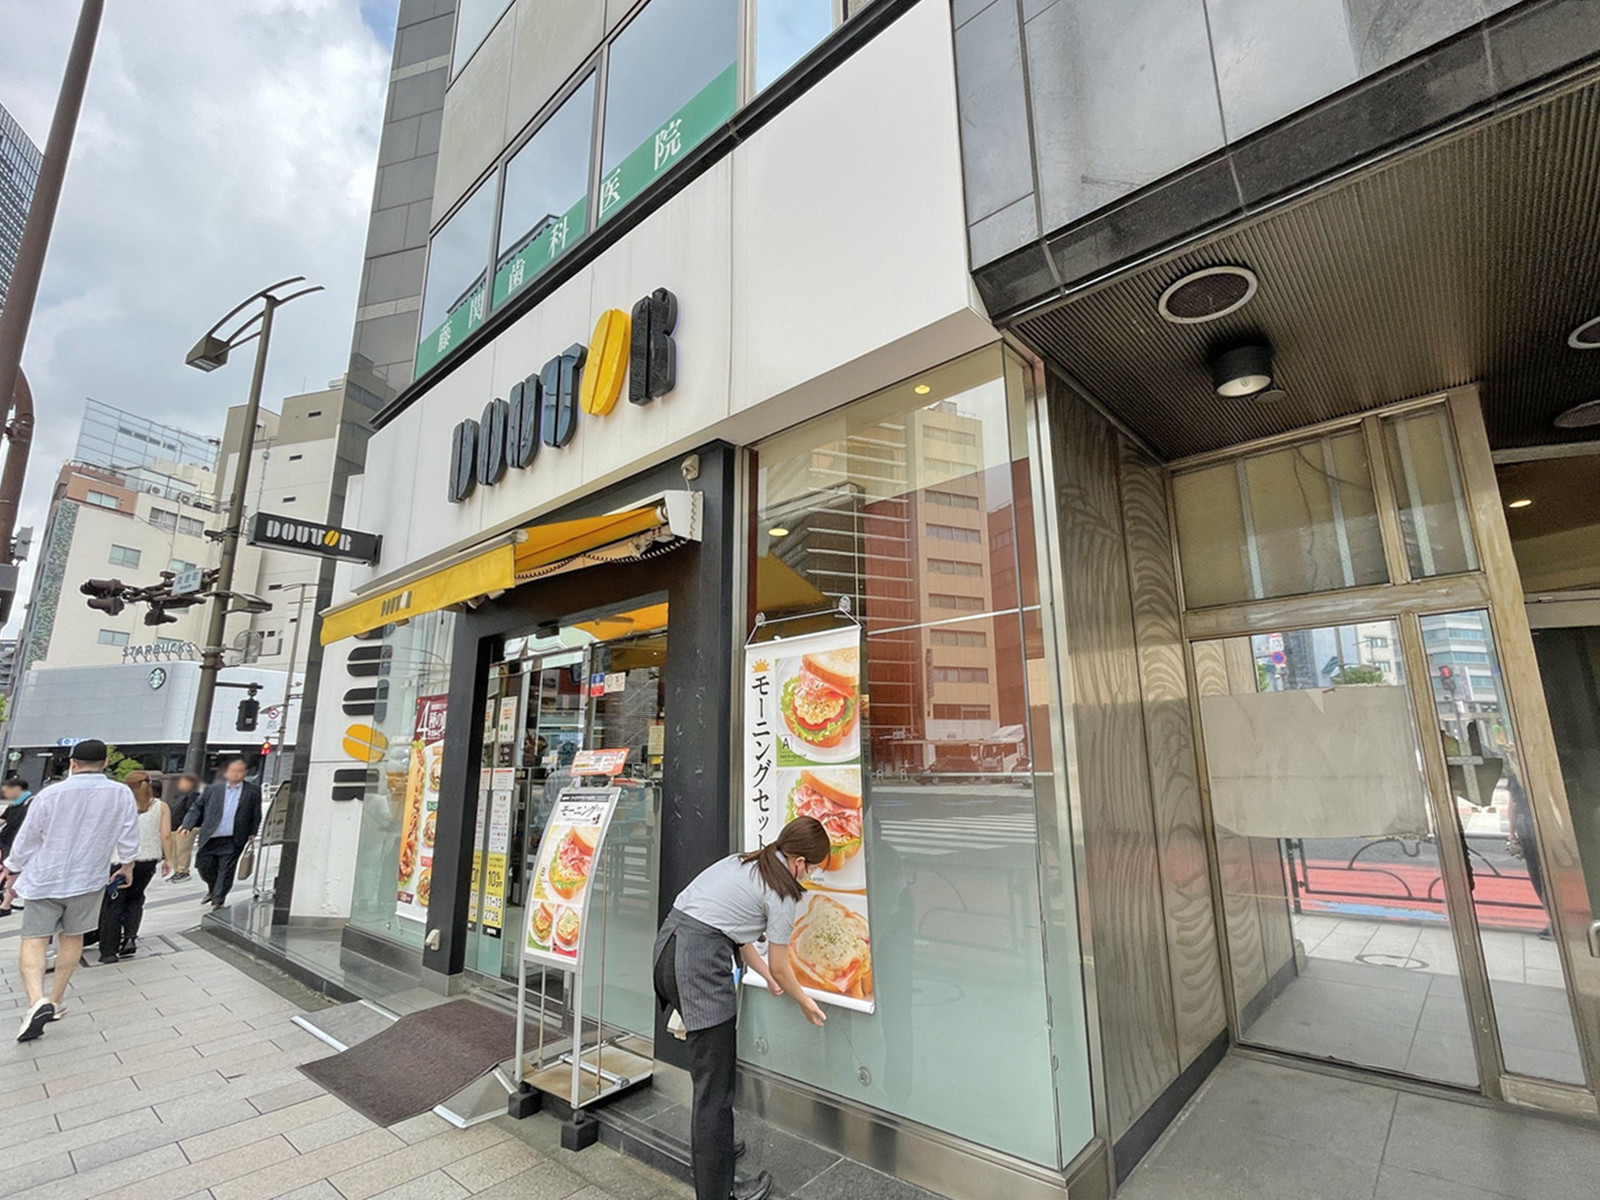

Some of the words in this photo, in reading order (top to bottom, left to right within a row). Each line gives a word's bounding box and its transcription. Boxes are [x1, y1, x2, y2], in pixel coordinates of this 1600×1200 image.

[448, 286, 679, 504] DOUTOR
[265, 519, 352, 552] DOUTOR
[121, 642, 194, 658] STARBUCKS
[782, 736, 792, 751] A
